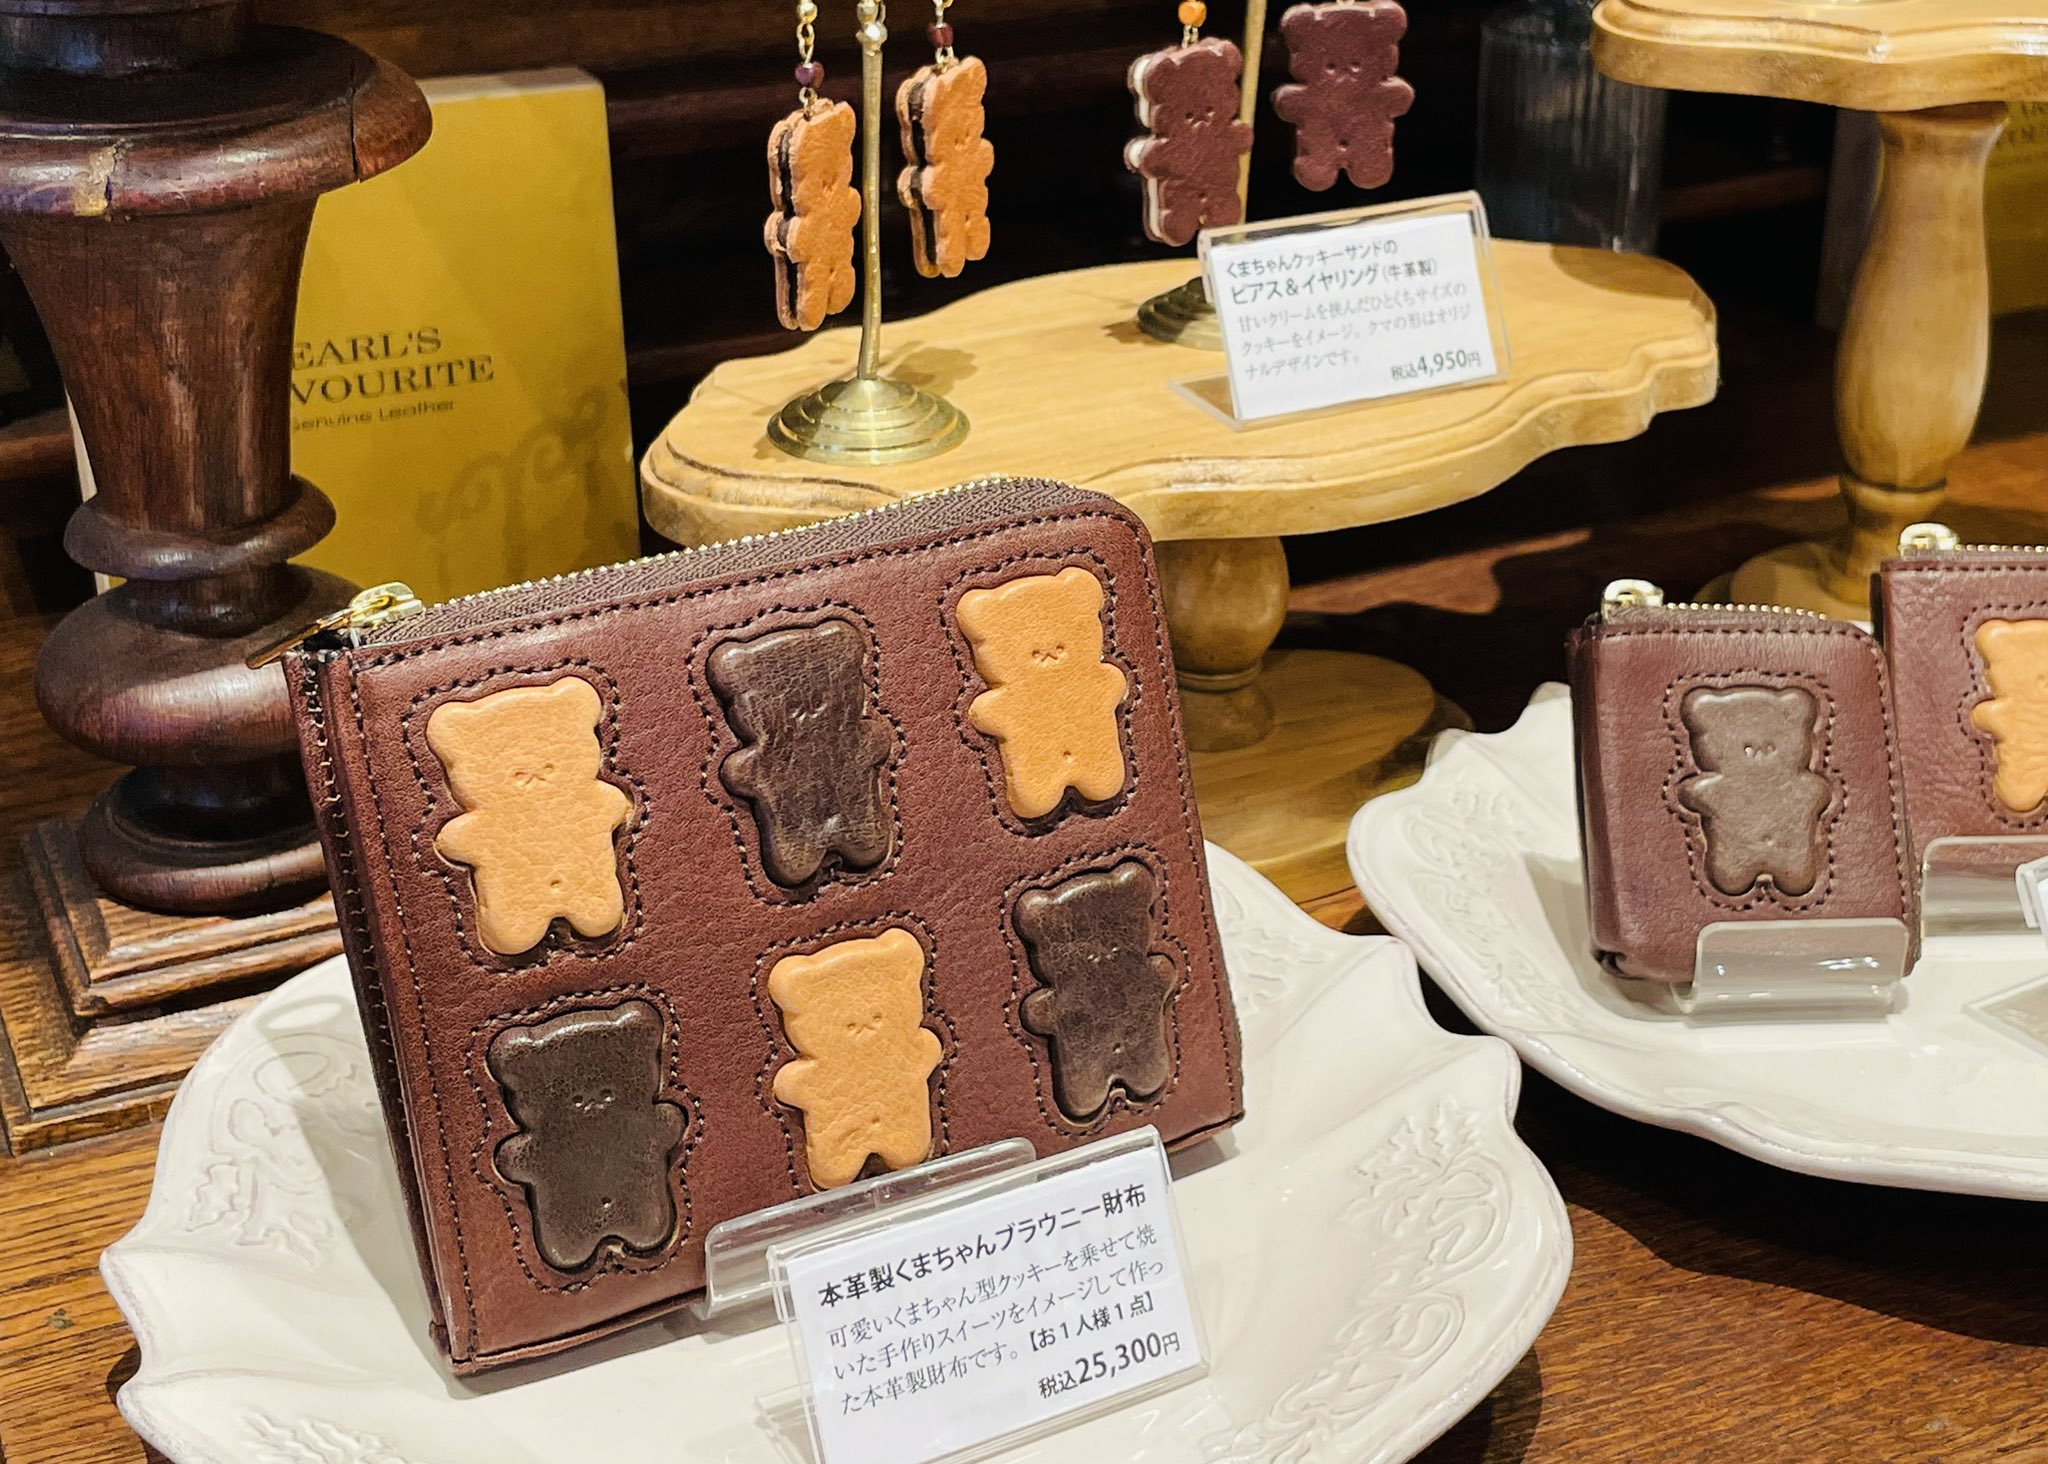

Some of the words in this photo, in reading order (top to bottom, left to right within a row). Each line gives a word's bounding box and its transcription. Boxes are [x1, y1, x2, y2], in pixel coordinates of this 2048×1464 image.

[1226, 239, 1398, 279] くまちゃんクッキーサンドの
[378, 399, 454, 422] Leather
[817, 1182, 1147, 1308] 本革製くまちゃんブラウニー財布
[826, 1223, 1157, 1349] 可愛いくまちゃん型クッキーを乗せて焼
[834, 1259, 1164, 1380] いた手作りスイーツをイメージして作っ
[1038, 1330, 1181, 1399] 税込25,300円
